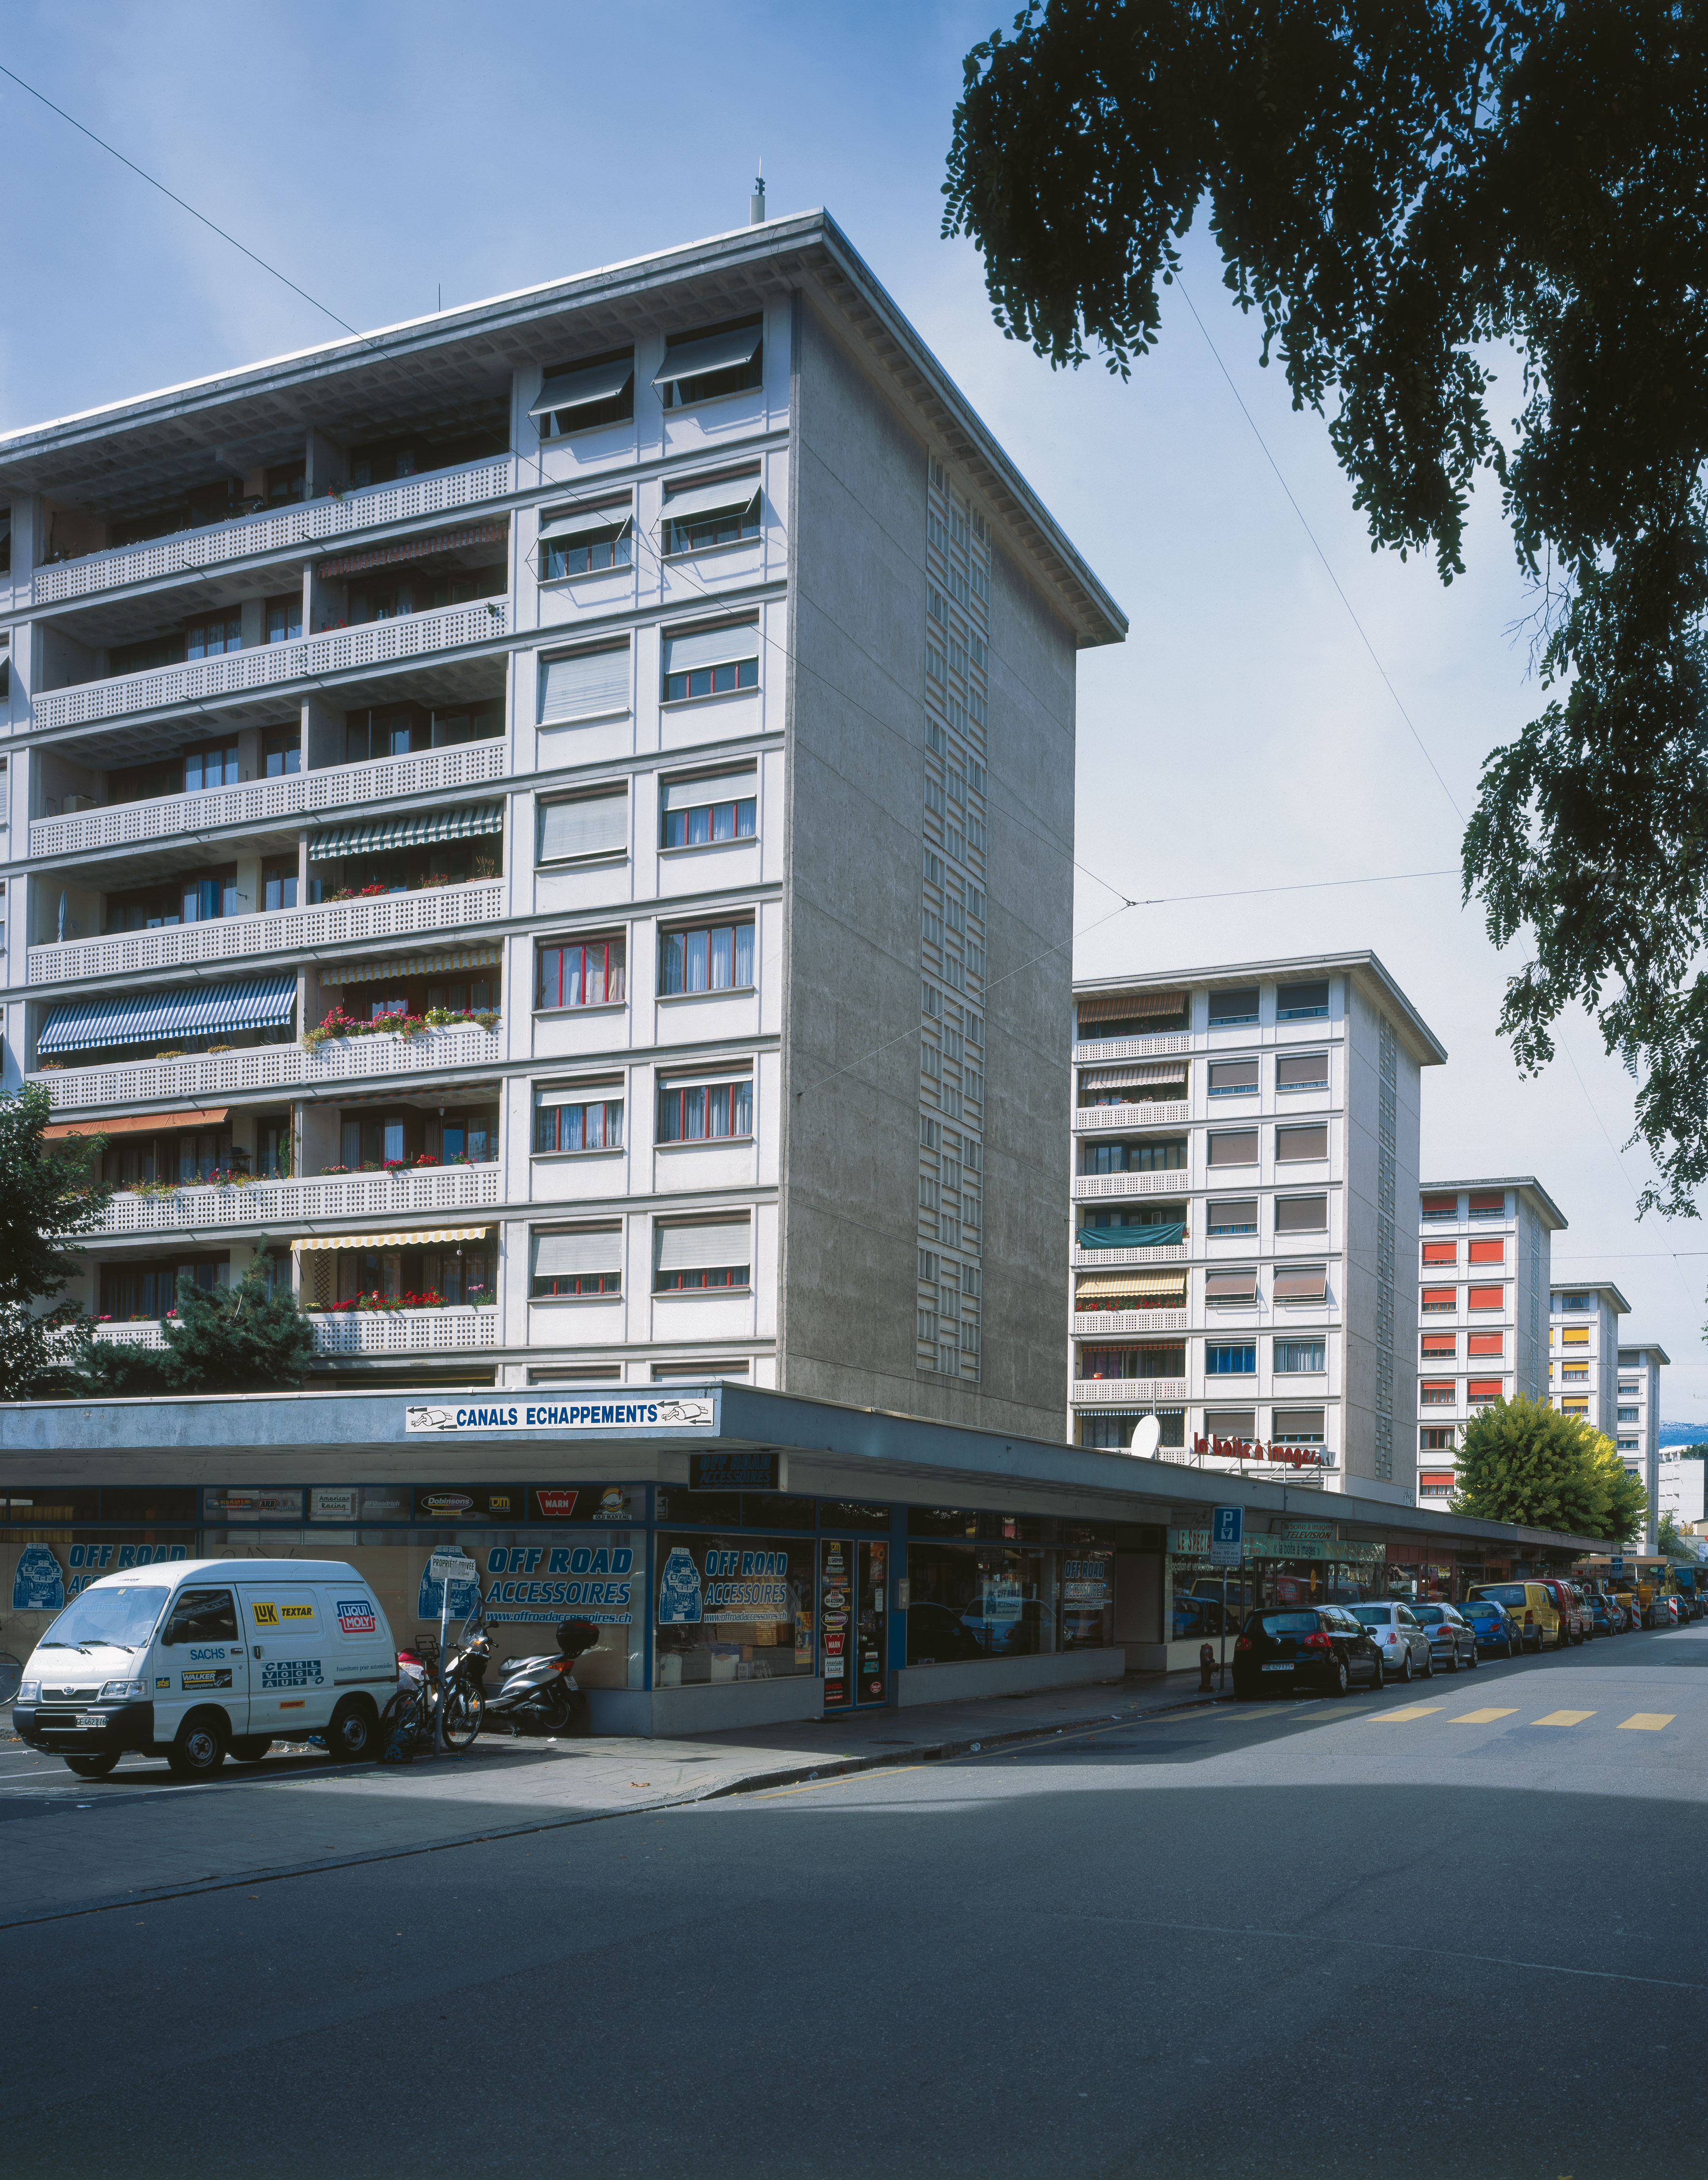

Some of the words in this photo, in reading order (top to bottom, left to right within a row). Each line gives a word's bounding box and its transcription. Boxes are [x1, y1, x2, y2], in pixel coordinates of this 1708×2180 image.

[457, 1407, 518, 1426] CANALS
[526, 1404, 658, 1425] ECHAPPEMENTS
[1194, 1432, 1208, 1454] la
[700, 1454, 727, 1470] OFF
[730, 1454, 771, 1470] ROAD
[699, 1470, 771, 1483] ACCESSOIRES
[321, 1502, 346, 1511] Racing
[545, 1500, 569, 1508] WARN
[1223, 1511, 1233, 1527] P
[1188, 1529, 1212, 1553] SPÉCIA
[1286, 1531, 1332, 1539] TELEVISION
[68, 1544, 114, 1568] OFF
[118, 1544, 188, 1568] ROAD
[1278, 1541, 1283, 1554] la
[1301, 1544, 1316, 1558] images
[433, 1558, 458, 1568] PROPRIÉÉ
[487, 1547, 543, 1574] OFF
[548, 1547, 634, 1575] ROAD
[705, 1549, 739, 1576] OFF
[741, 1551, 788, 1577] ROAD
[1065, 1560, 1081, 1579] OFF
[1082, 1561, 1105, 1579] ROAD
[485, 1580, 632, 1605] ACCESSOIRES
[704, 1582, 787, 1605] ACCESSOIRES
[1064, 1582, 1104, 1599] ACCESSOIRES
[282, 1607, 312, 1616] TEXTAR
[343, 1605, 368, 1616] LIQUI
[704, 1610, 787, 1623] www.offroadaccessoires.ch
[346, 1616, 370, 1628] MOLY
[190, 1648, 225, 1660] SACHS
[264, 1661, 319, 1671] CARL
[182, 1672, 216, 1682] WALKER
[264, 1669, 319, 1679] VOGT
